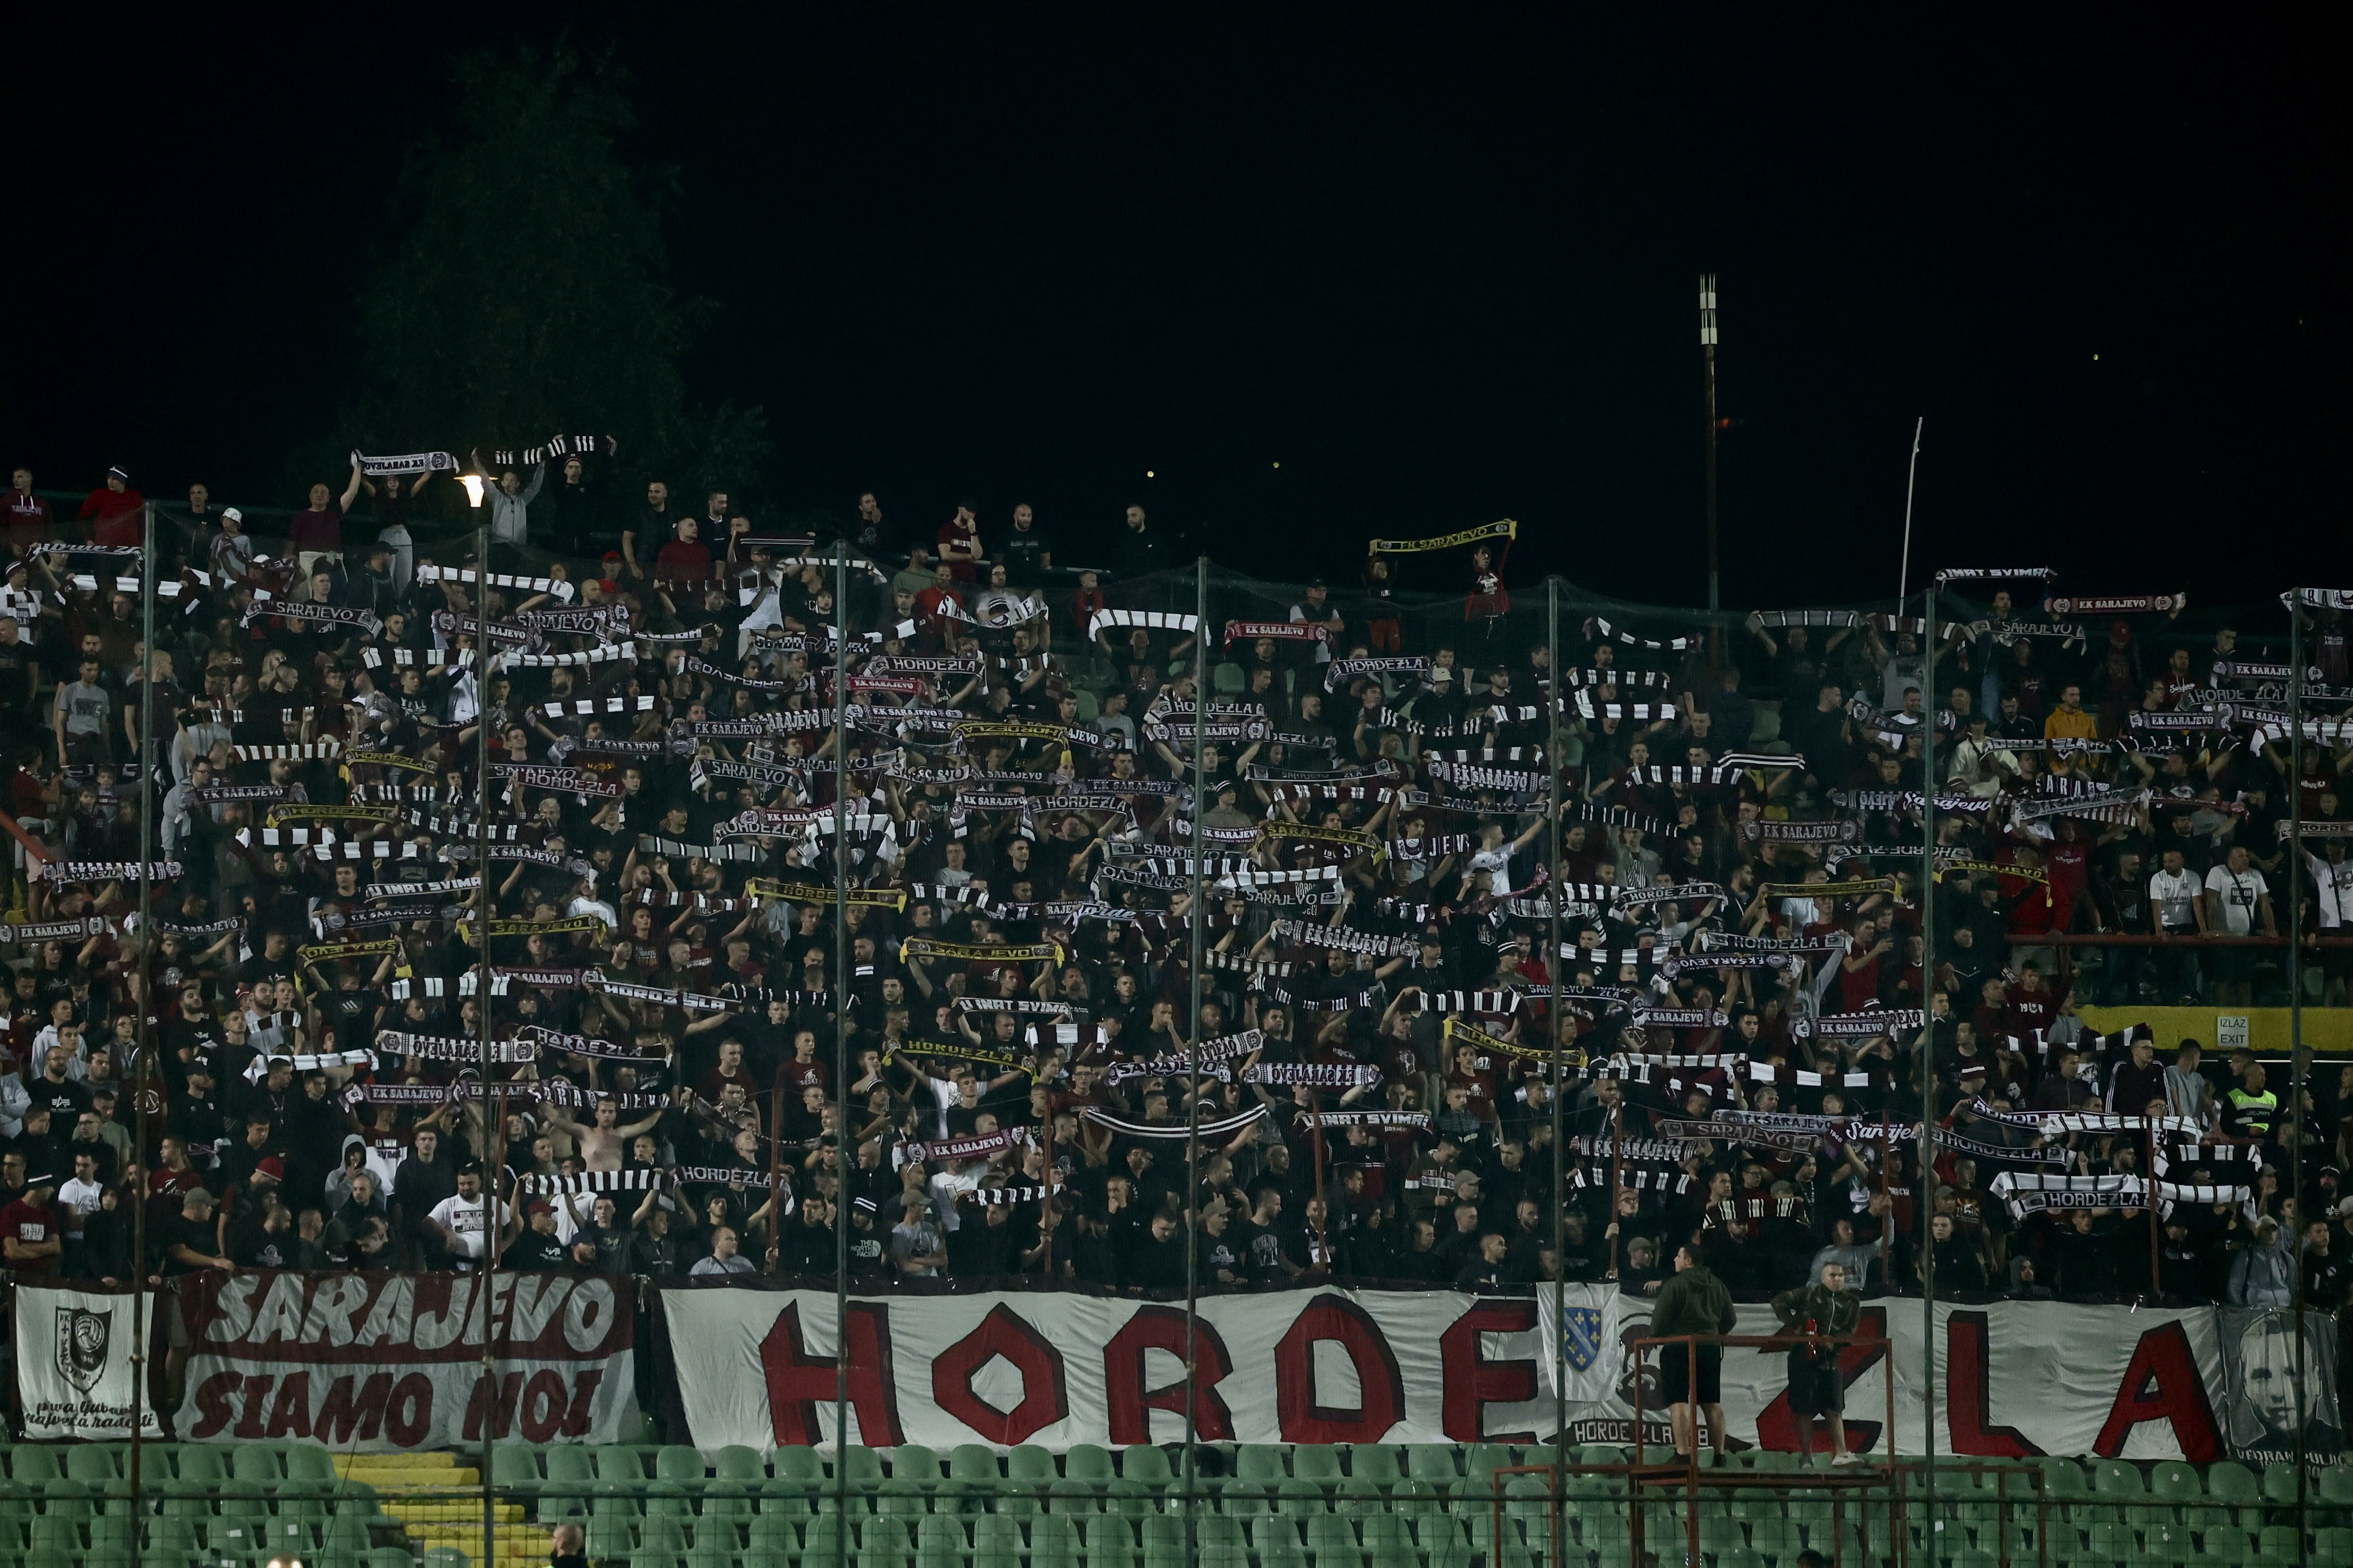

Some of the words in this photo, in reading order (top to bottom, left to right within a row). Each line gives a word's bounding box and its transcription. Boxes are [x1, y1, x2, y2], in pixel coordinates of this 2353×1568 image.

[2095, 599, 2146, 608] SARAJEVO
[276, 601, 353, 620] SARAJEVO
[517, 615, 595, 630] SARAJEVO
[487, 626, 526, 639] ARAJEVO
[1260, 626, 1303, 636] SARAJEVO
[2252, 666, 2293, 676] SARAJEV
[868, 681, 914, 690] SARAJEVO
[889, 708, 937, 717] SARAJEVO
[2166, 716, 2214, 726] SARAJEVO
[709, 724, 762, 735] SARAJEVO
[605, 741, 660, 751] SARAJEVO
[713, 760, 785, 784] SARAJEVO
[1471, 766, 1528, 792] SARAJEVO
[223, 787, 283, 799] SARAJEVO
[1113, 781, 1172, 793] SARAJEVO
[782, 808, 833, 822] SARAJEVO
[1782, 825, 1837, 839] SARAJEVO
[35, 923, 81, 937] SARAJEVO
[1653, 1012, 1703, 1022] SARAJEVO
[2220, 1018, 2246, 1028] IZLAZ
[1836, 1022, 1883, 1033] SARAJEVO
[2221, 1035, 2245, 1044] EXIT
[390, 1088, 443, 1099] SARAJEVO
[952, 1136, 1004, 1154] SARAJEVO
[205, 1273, 616, 1352] SARAJEVO
[758, 1295, 1538, 1445] HORDE
[190, 1370, 432, 1447] SIAMO
[461, 1369, 603, 1443] NOI
[1575, 1422, 1631, 1442] HORDE
